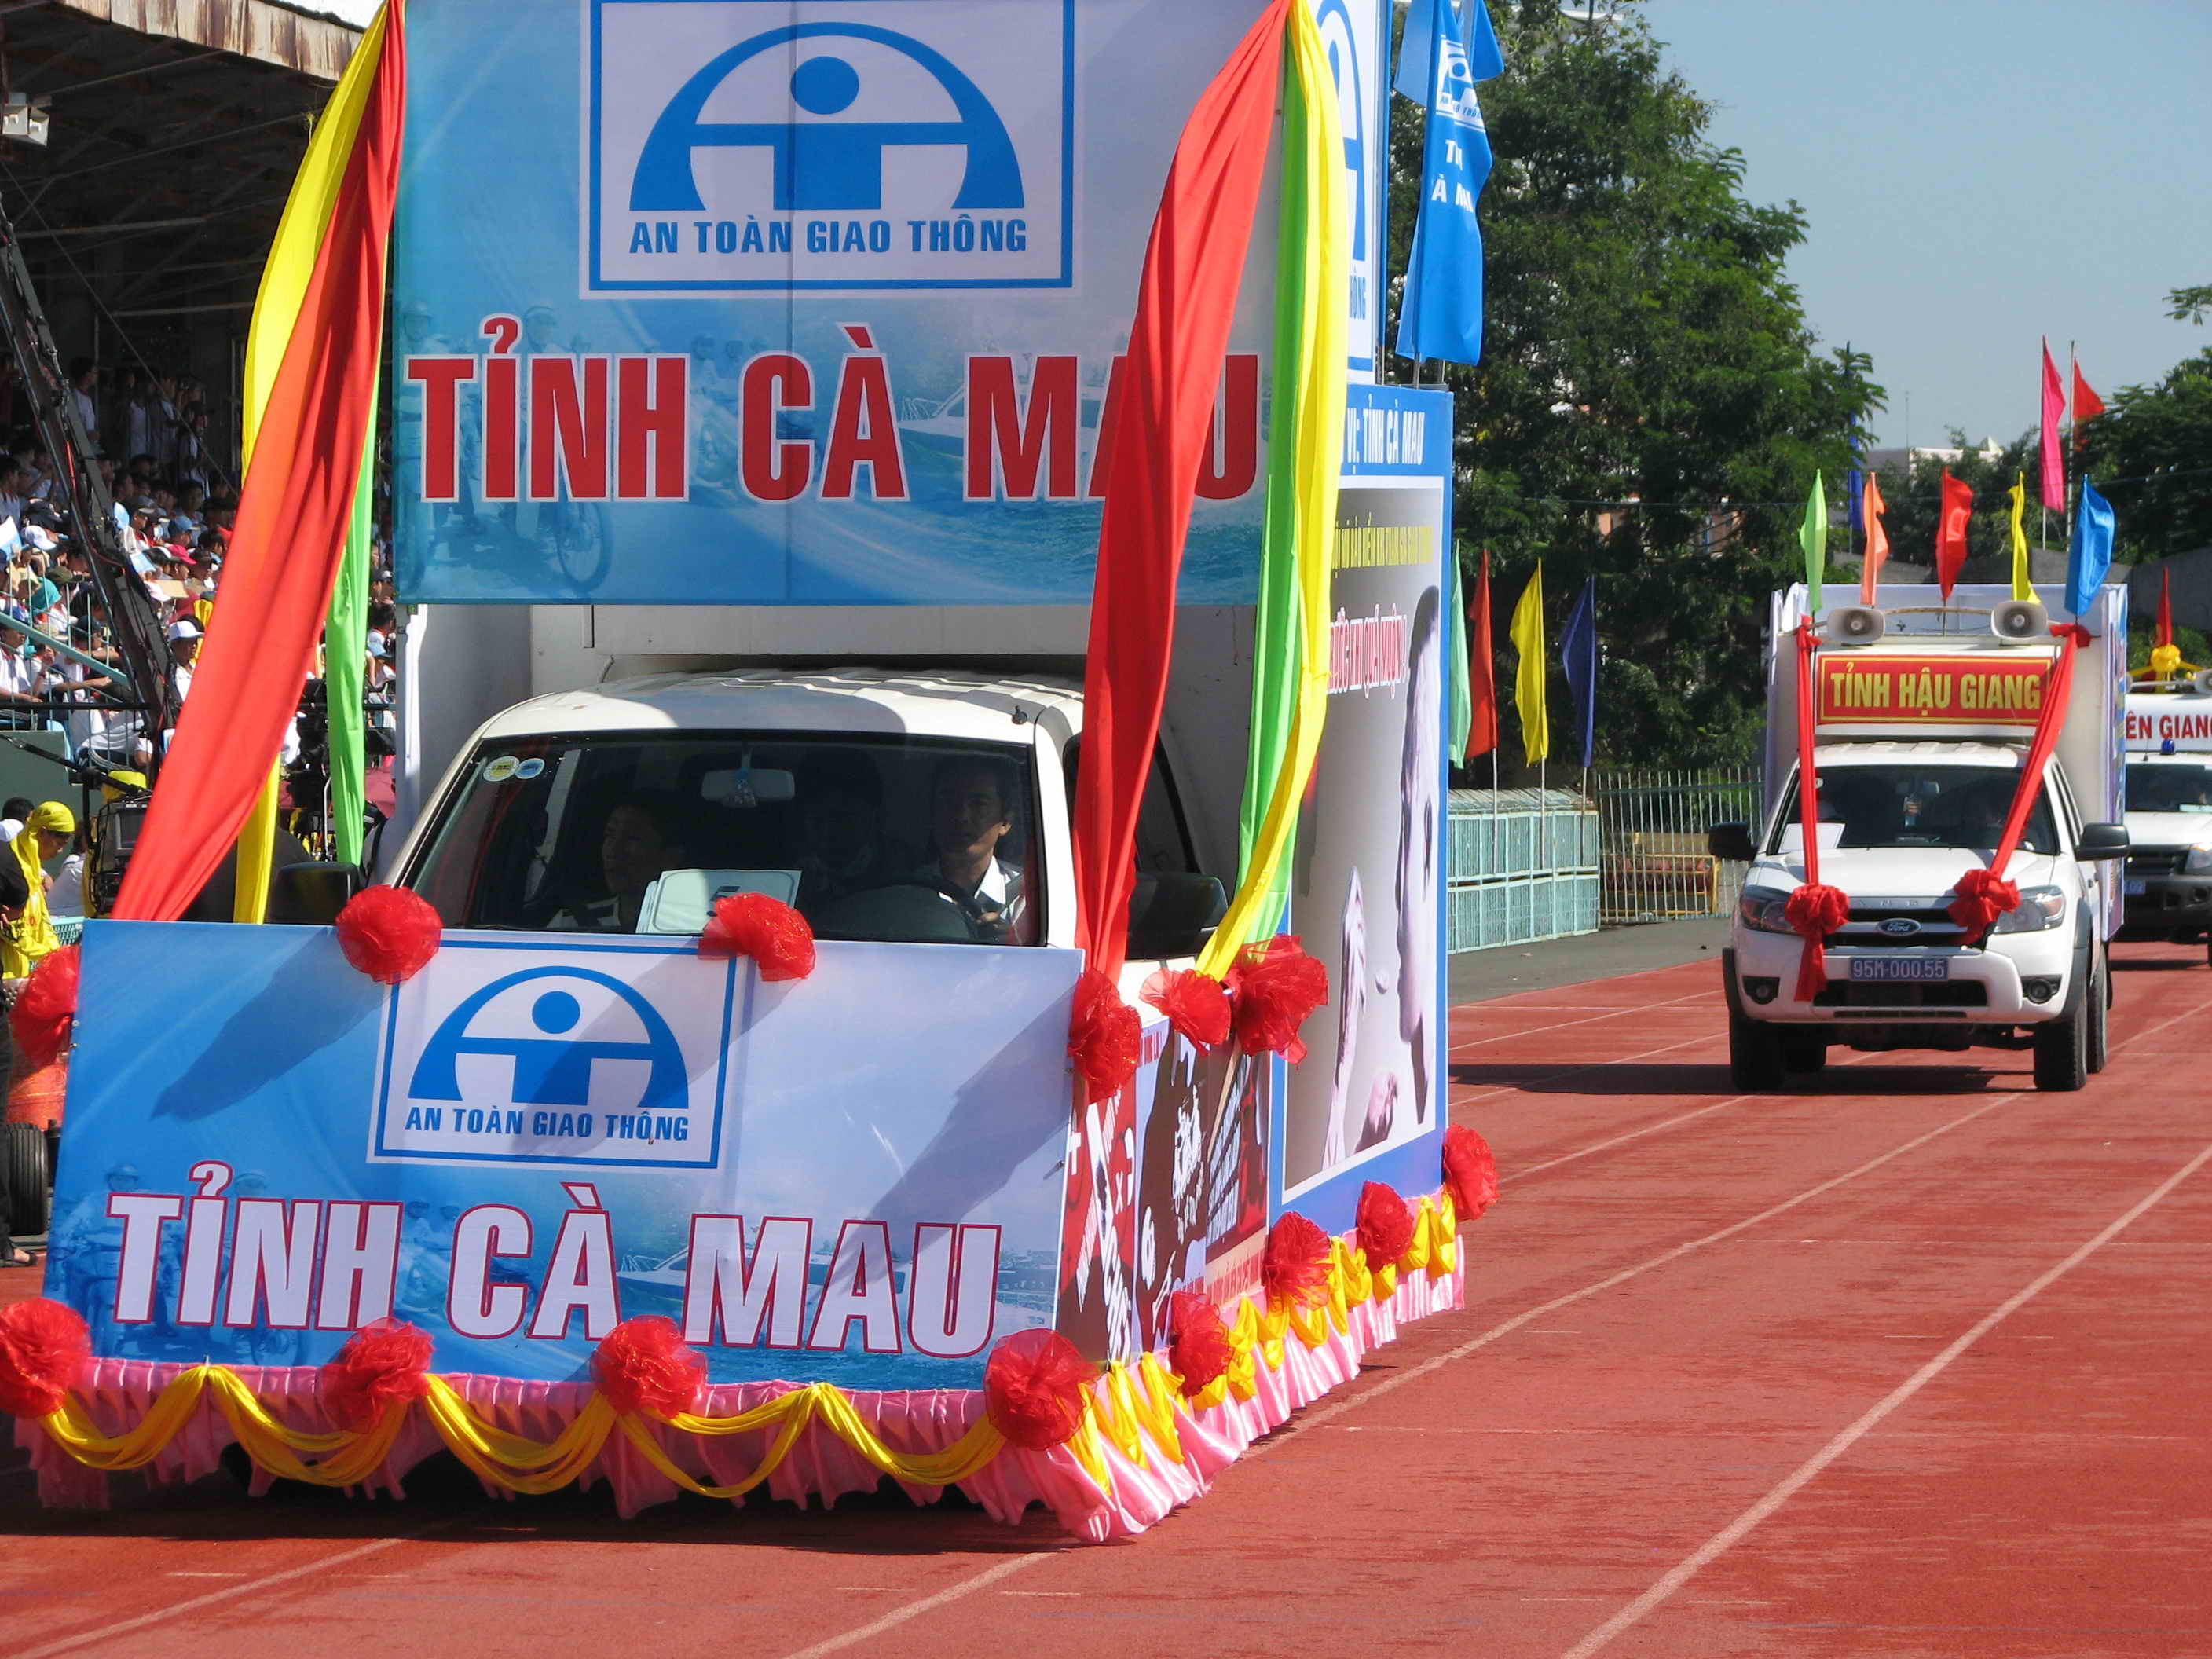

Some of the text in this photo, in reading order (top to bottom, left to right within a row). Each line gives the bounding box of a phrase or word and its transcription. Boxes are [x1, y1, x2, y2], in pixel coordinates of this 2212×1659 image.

[629, 214, 1027, 254] AN TOÀN GIAO THÔNG
[404, 314, 690, 502] TỈNH
[738, 322, 910, 504] CÀ
[1363, 393, 1384, 463] TỈNH
[1386, 398, 1399, 465] CÀ
[1402, 410, 1425, 466] MAU
[1830, 661, 2041, 716] TỈNH HẬU GIANG
[2159, 713, 2212, 739] GIAN
[1887, 921, 1910, 932] Ford
[405, 1105, 689, 1141] AN TOÀN GIAO THÔNG
[106, 1159, 1002, 1359] TỈNH CÀ MAU
